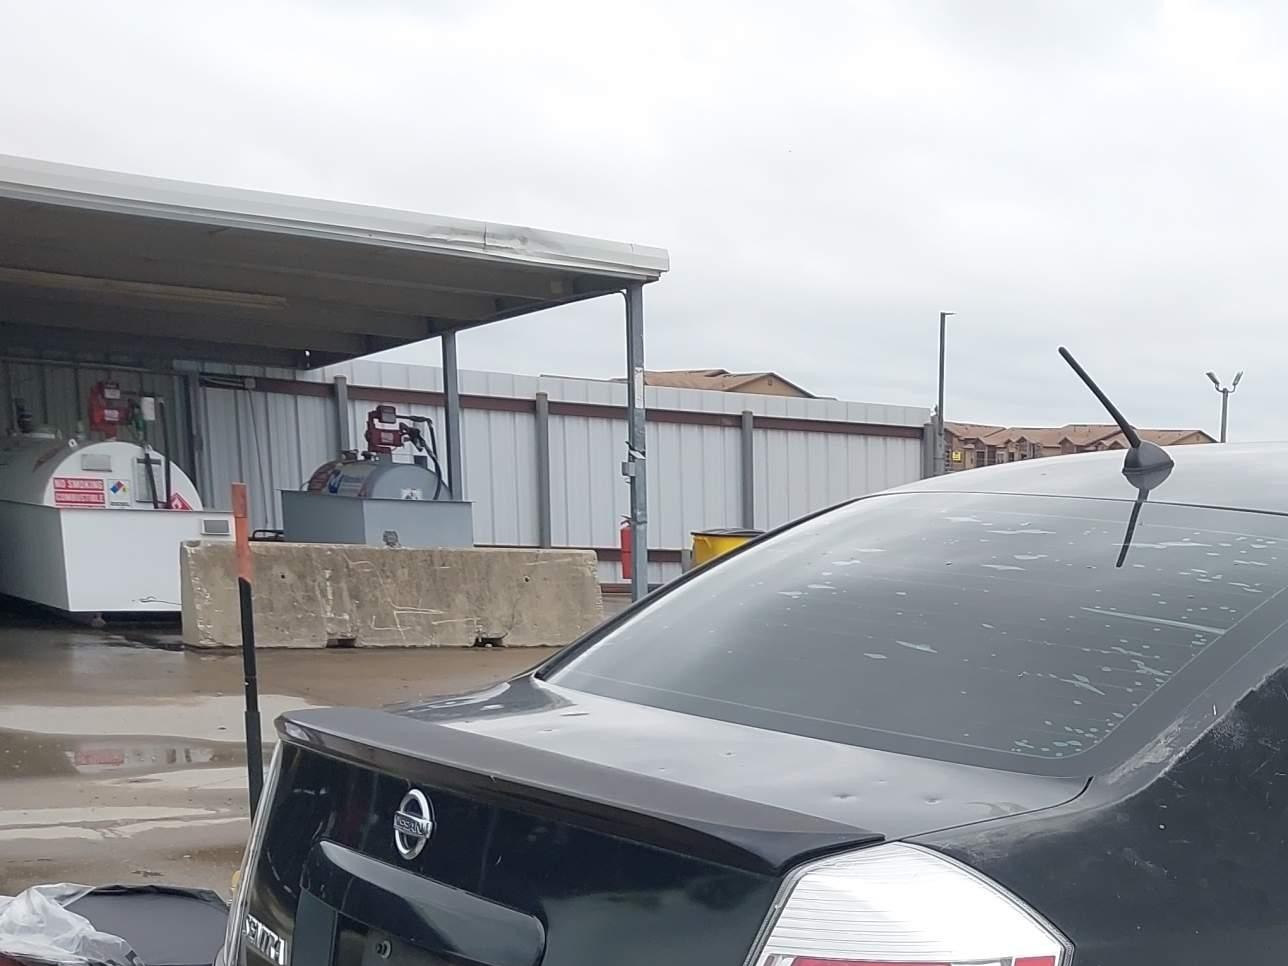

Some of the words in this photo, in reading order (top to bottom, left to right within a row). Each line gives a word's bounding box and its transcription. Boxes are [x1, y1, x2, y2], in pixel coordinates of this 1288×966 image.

[54, 479, 66, 489] NO
[67, 480, 104, 491] SMOKING
[395, 814, 431, 837] NISSAN
